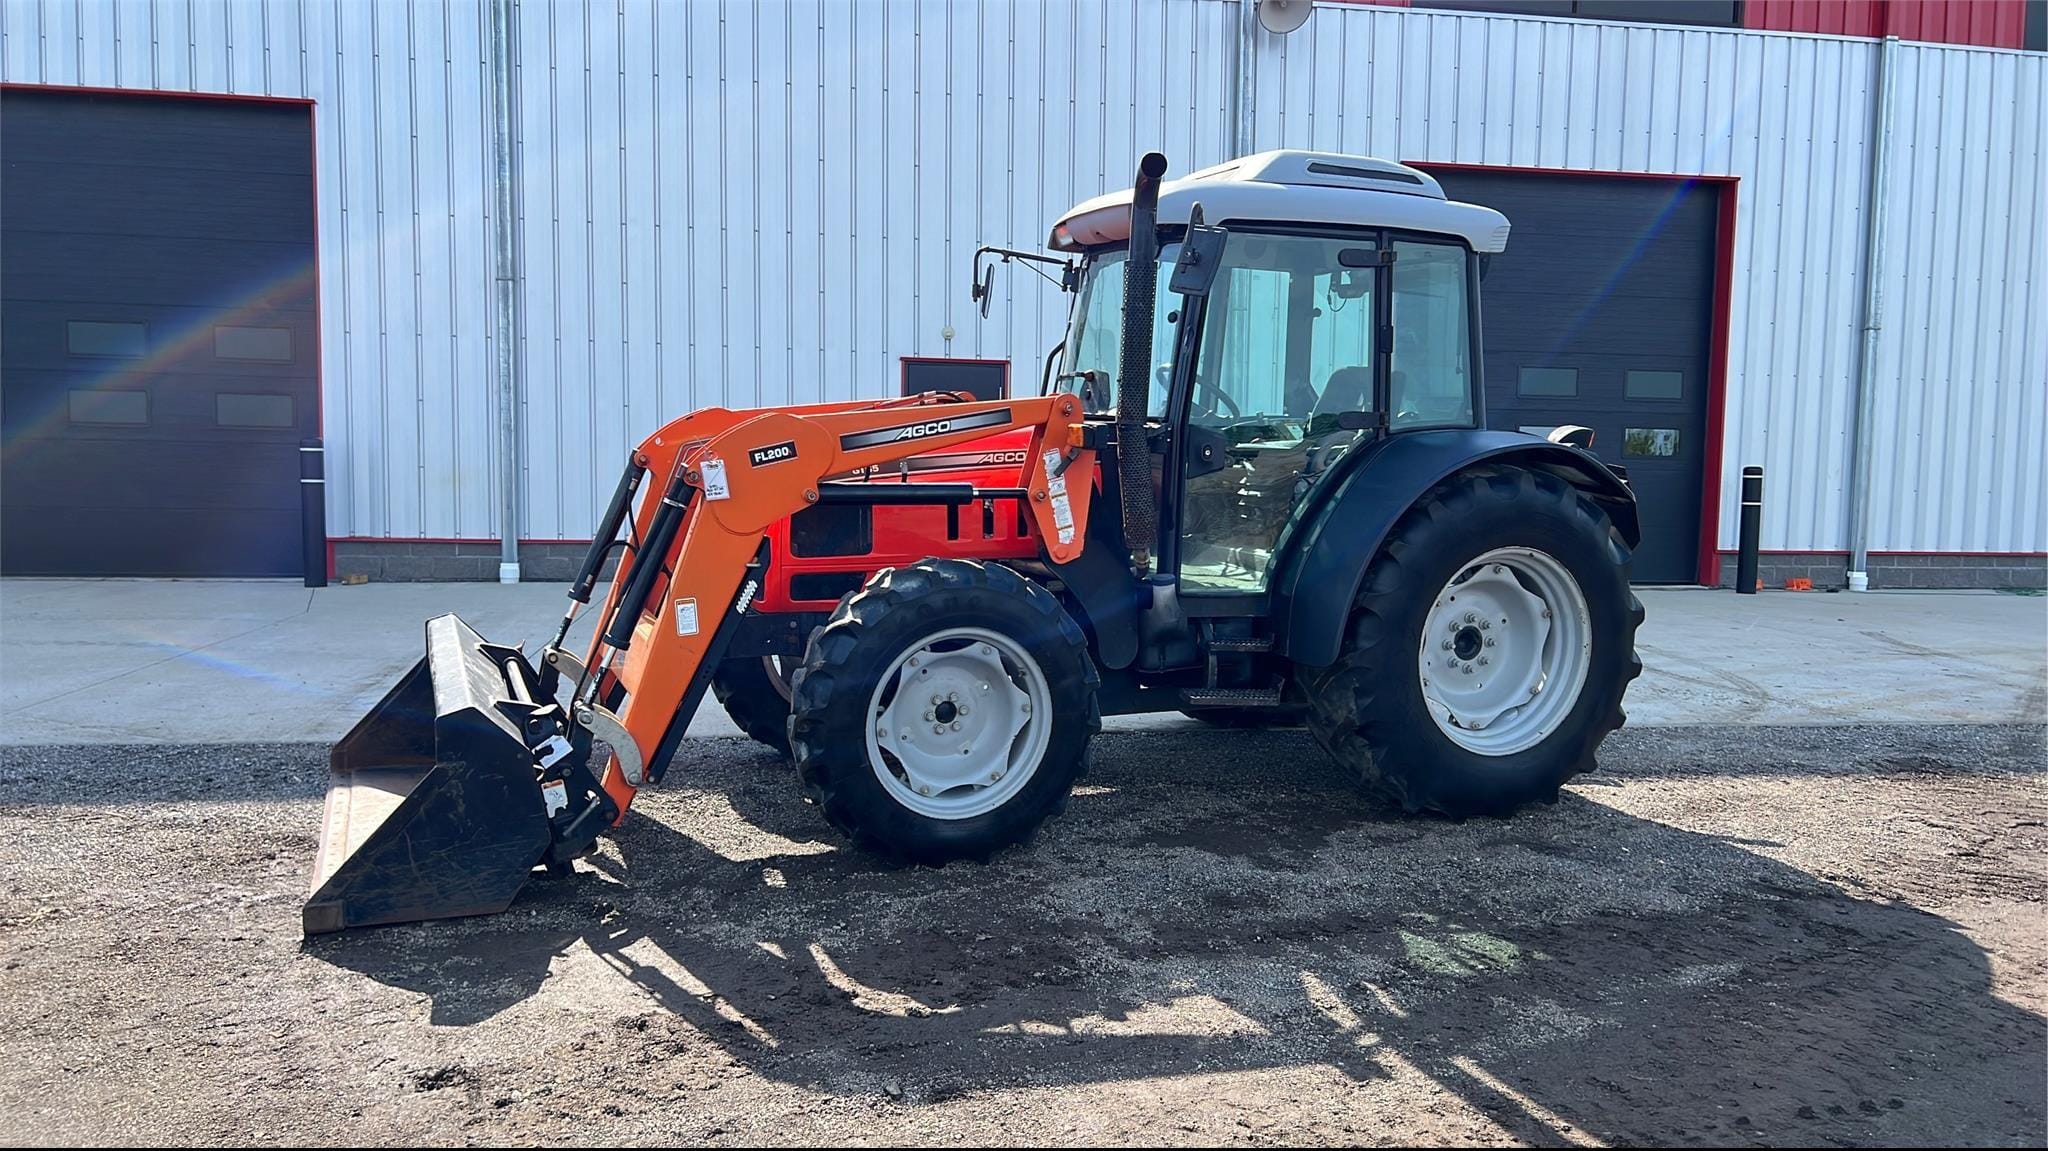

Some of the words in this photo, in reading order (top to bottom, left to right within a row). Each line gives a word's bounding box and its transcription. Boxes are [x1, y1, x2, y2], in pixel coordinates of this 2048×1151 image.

[895, 420, 951, 440] AGCO
[754, 446, 789, 463] FL200
[978, 451, 1027, 464] AGCO
